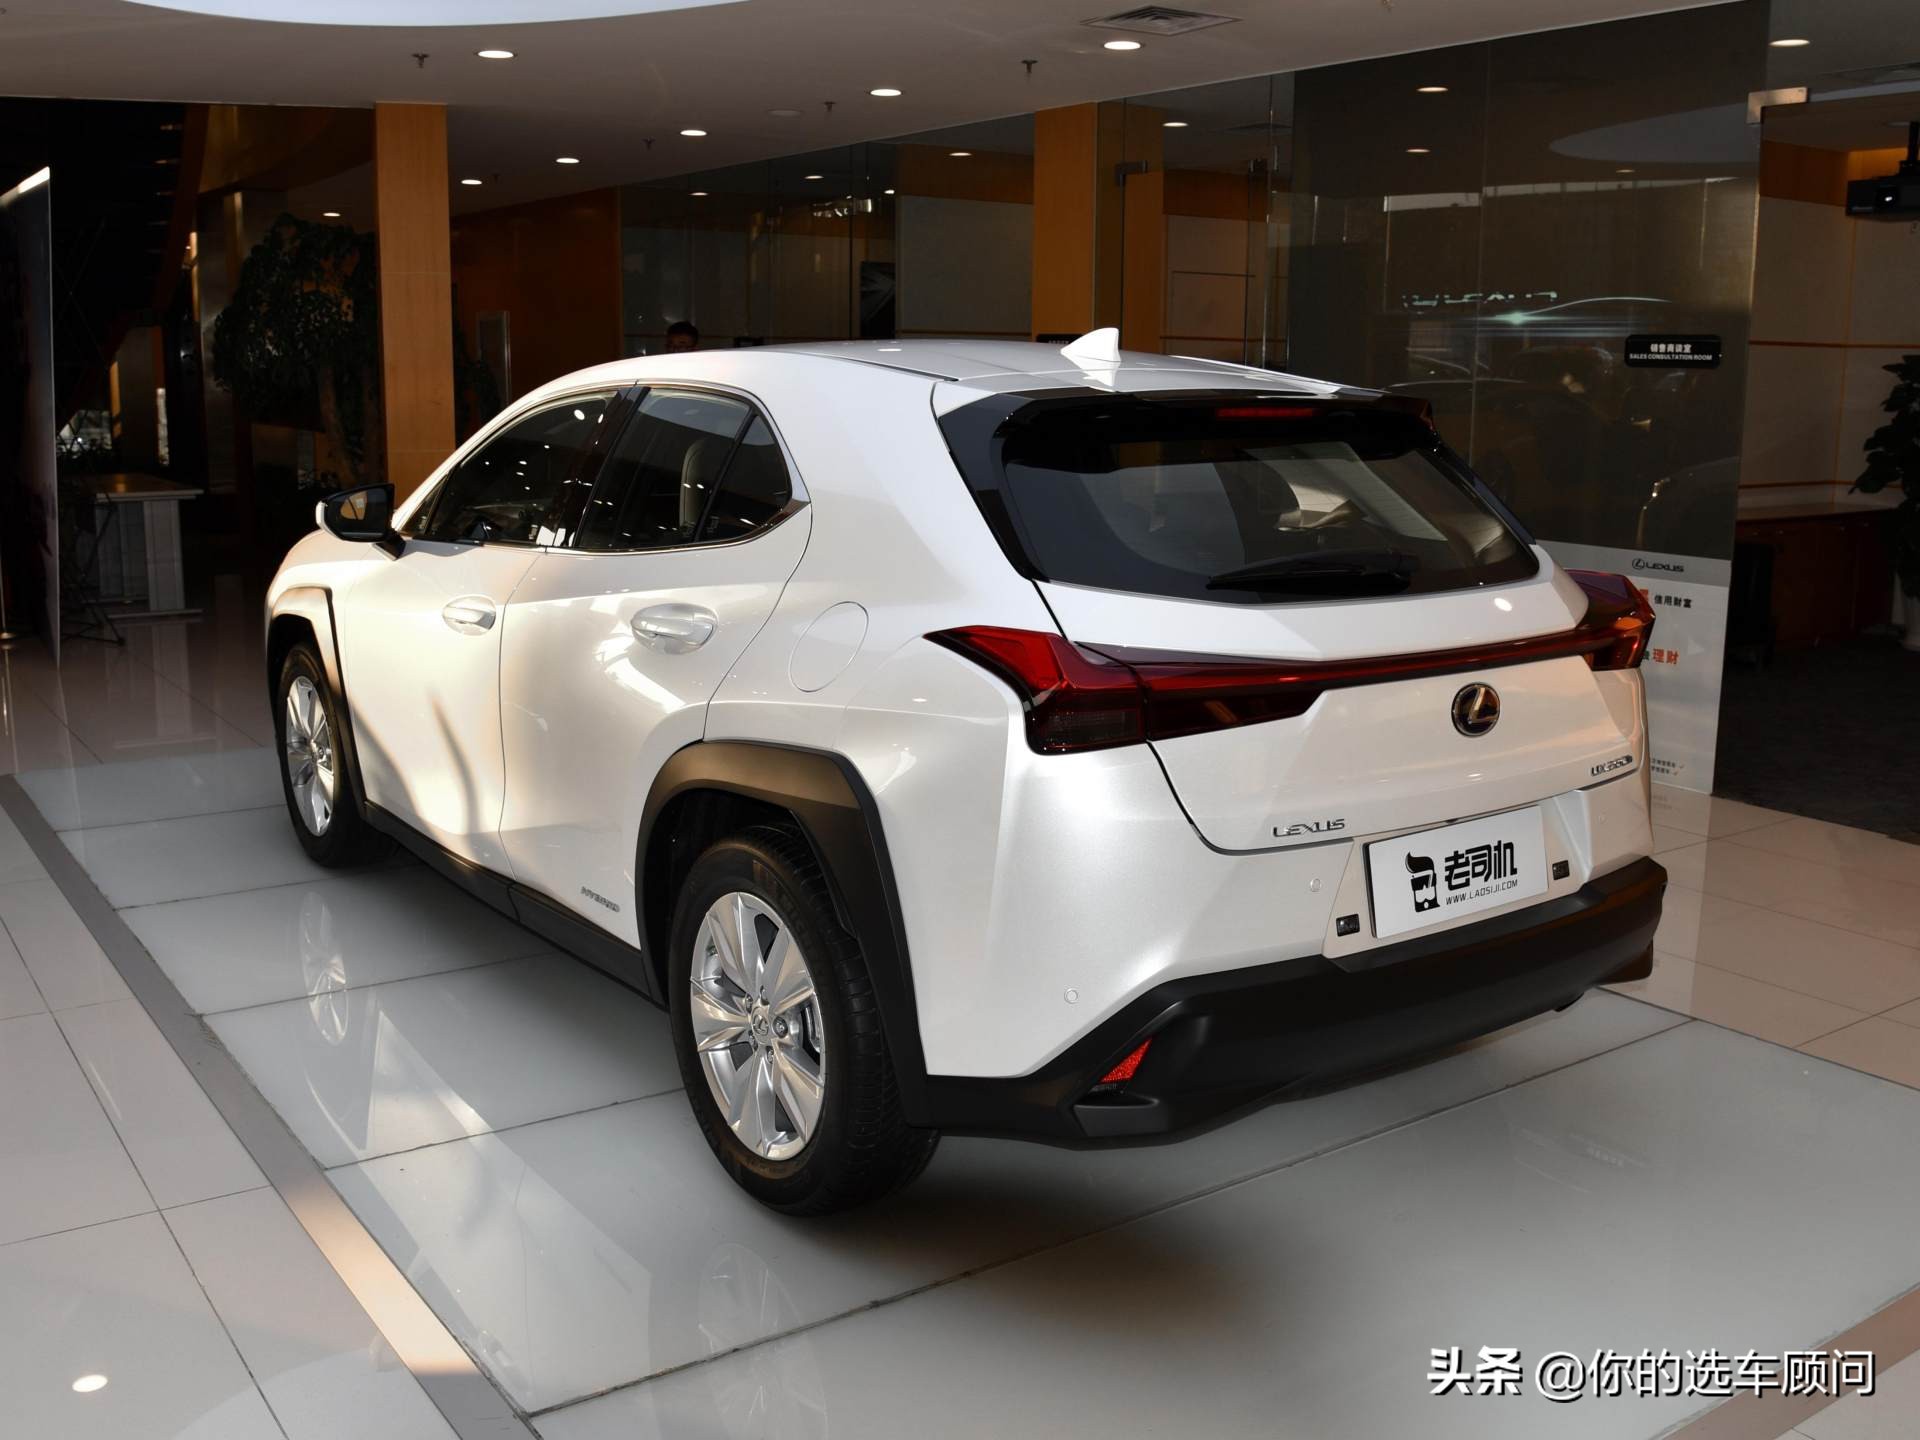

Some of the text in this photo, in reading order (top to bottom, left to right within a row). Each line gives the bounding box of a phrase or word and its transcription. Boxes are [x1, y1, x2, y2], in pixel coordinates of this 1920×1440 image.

[1647, 353, 1693, 361] CONSULTATION
[1646, 562, 1685, 573] LEXUS
[1273, 818, 1345, 838] LEXUS
[1444, 839, 1518, 891] 老司机
[580, 886, 621, 913] HYBRID
[1445, 879, 1519, 906] WWW.LAOSIJI.COM
